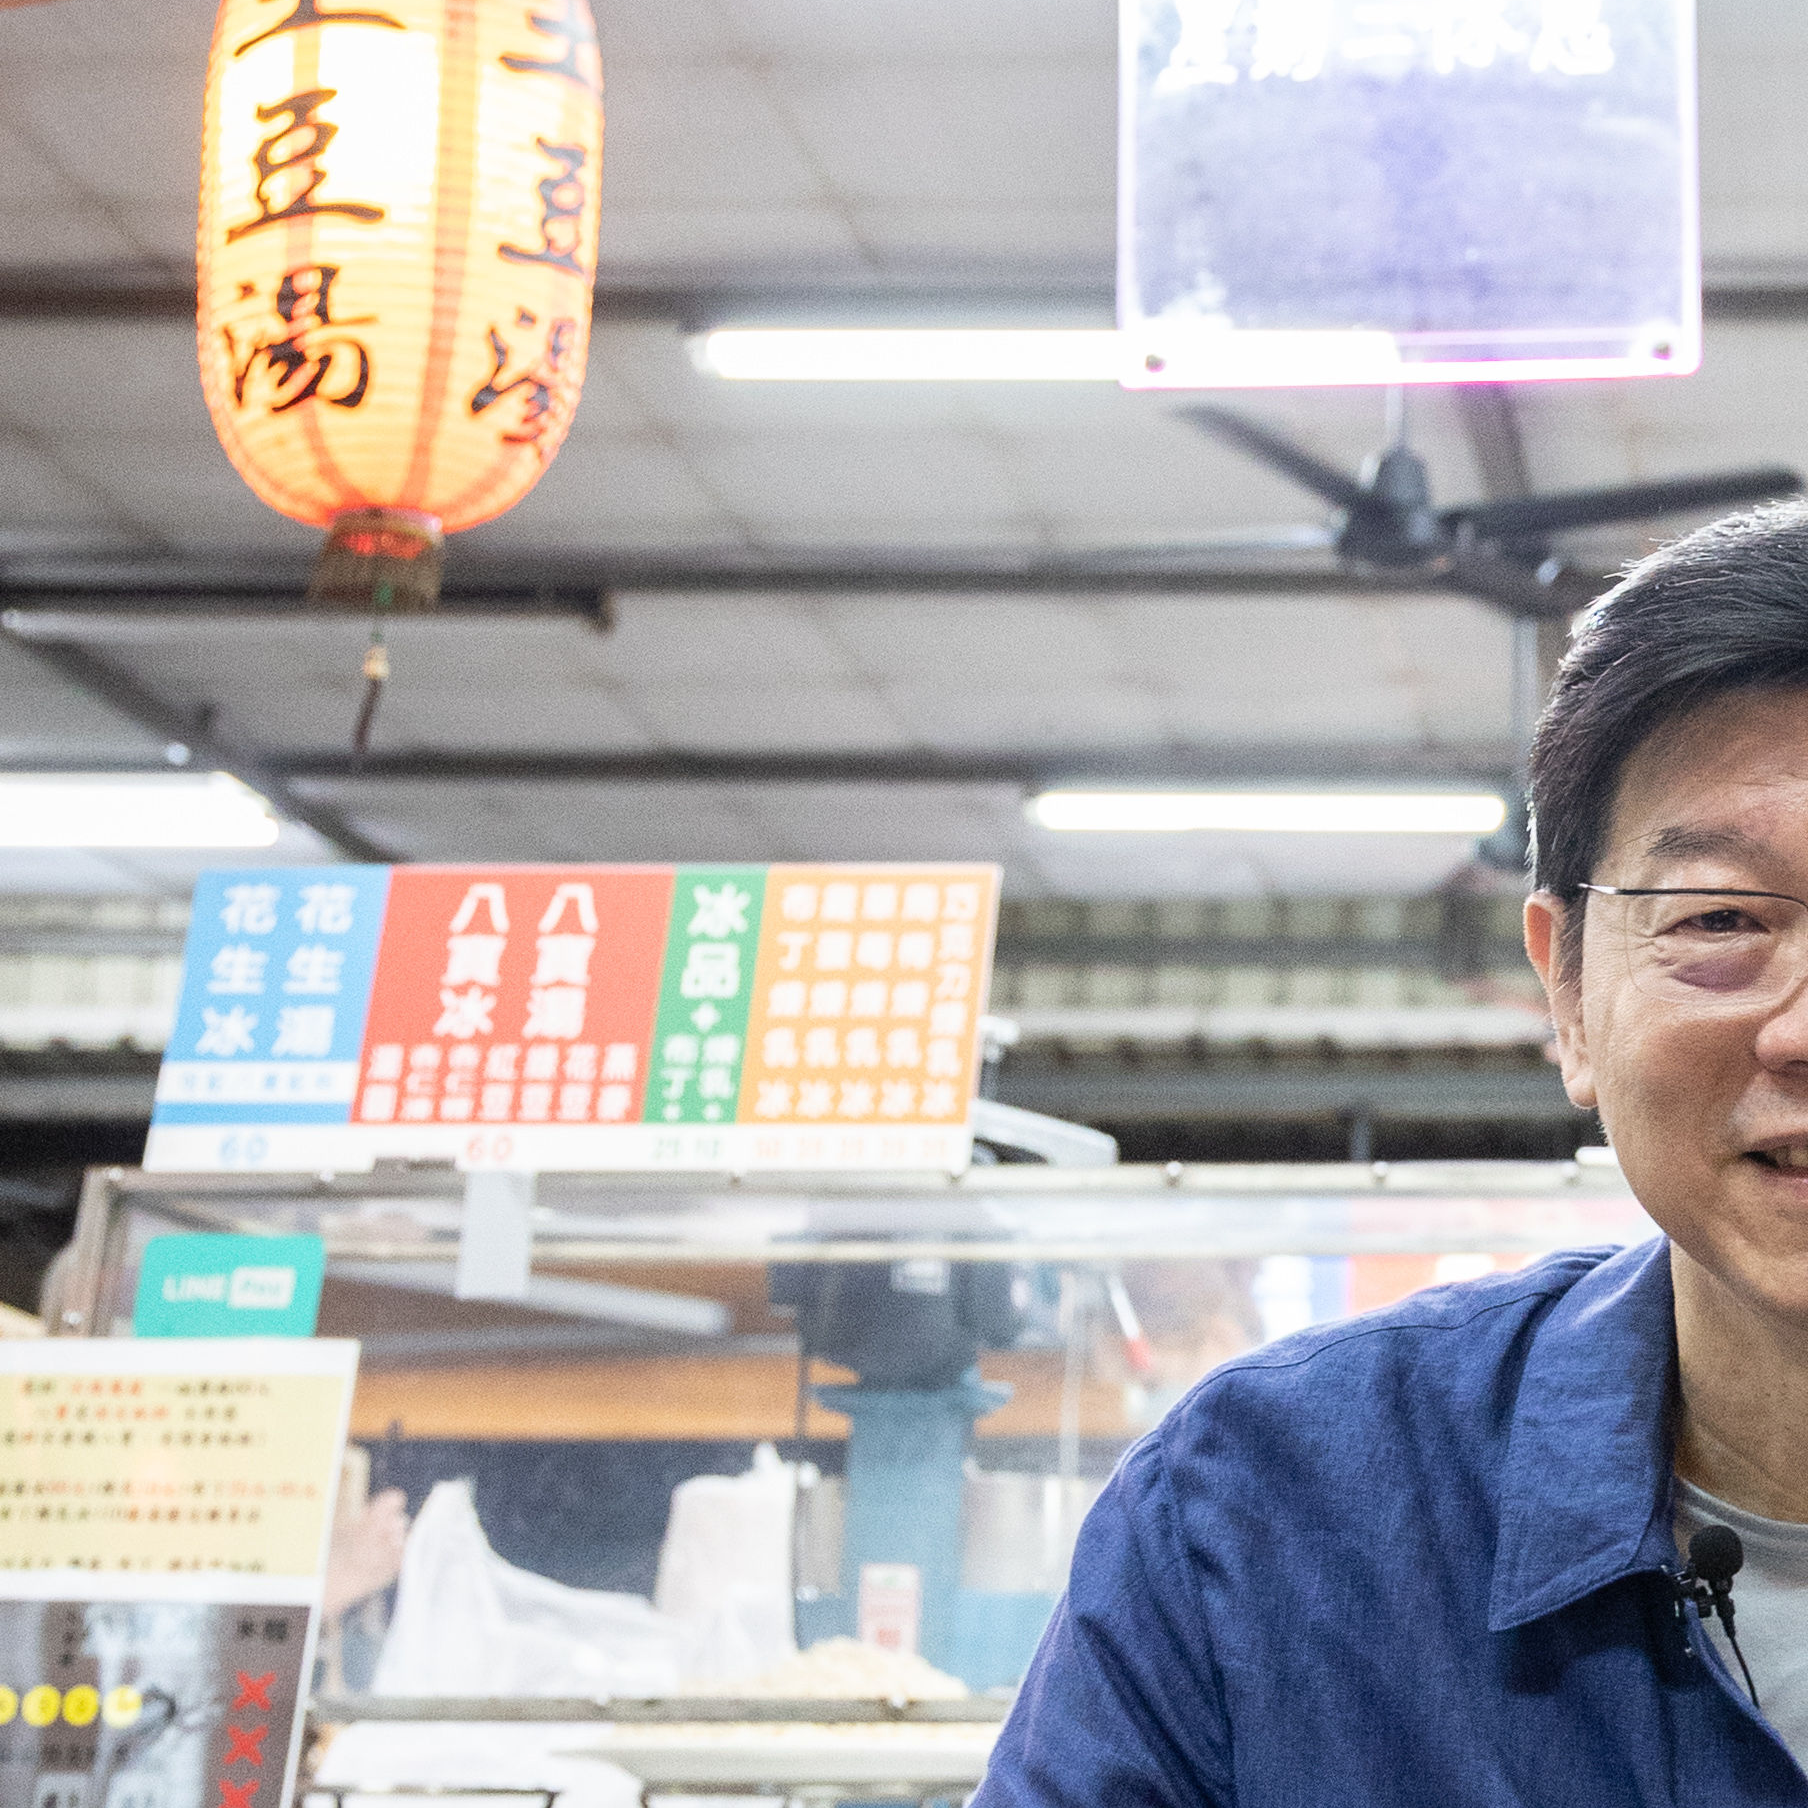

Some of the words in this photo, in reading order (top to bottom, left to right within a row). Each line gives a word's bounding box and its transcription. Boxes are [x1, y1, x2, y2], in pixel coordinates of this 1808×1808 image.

[195, 883, 282, 1057] 花生冰
[465, 1132, 513, 1163] 60
